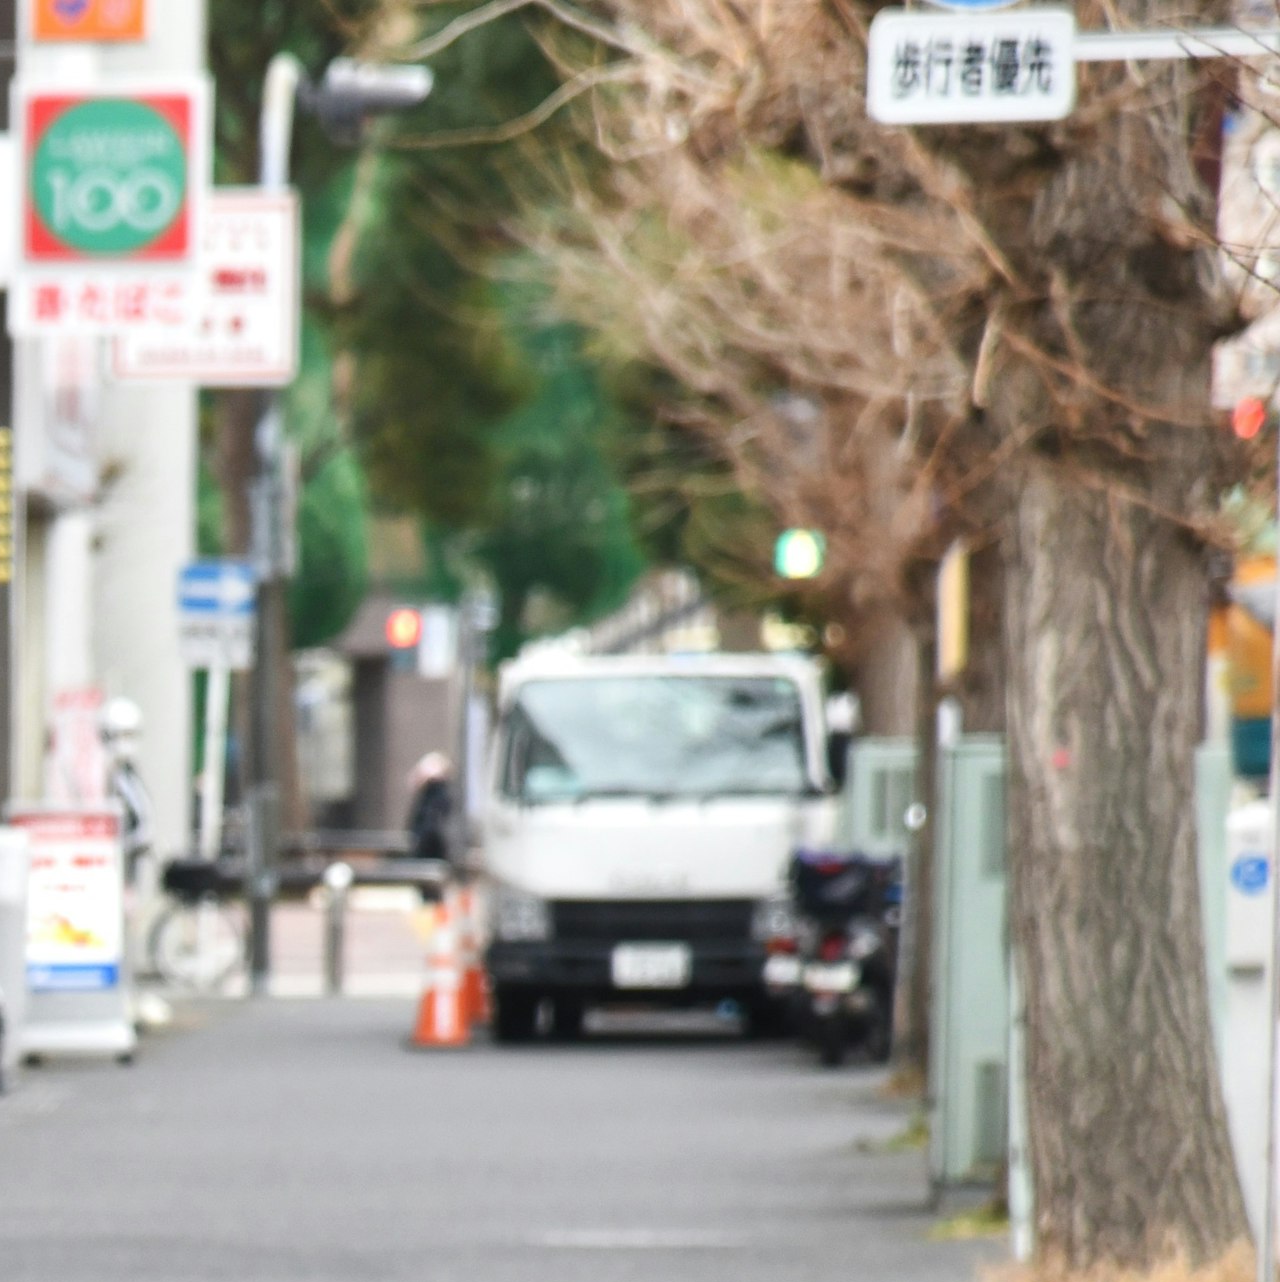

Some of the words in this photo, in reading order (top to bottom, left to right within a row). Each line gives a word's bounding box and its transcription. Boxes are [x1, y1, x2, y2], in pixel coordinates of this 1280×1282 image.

[893, 37, 1052, 97] 歩行者優先
[48, 168, 174, 231] 100
